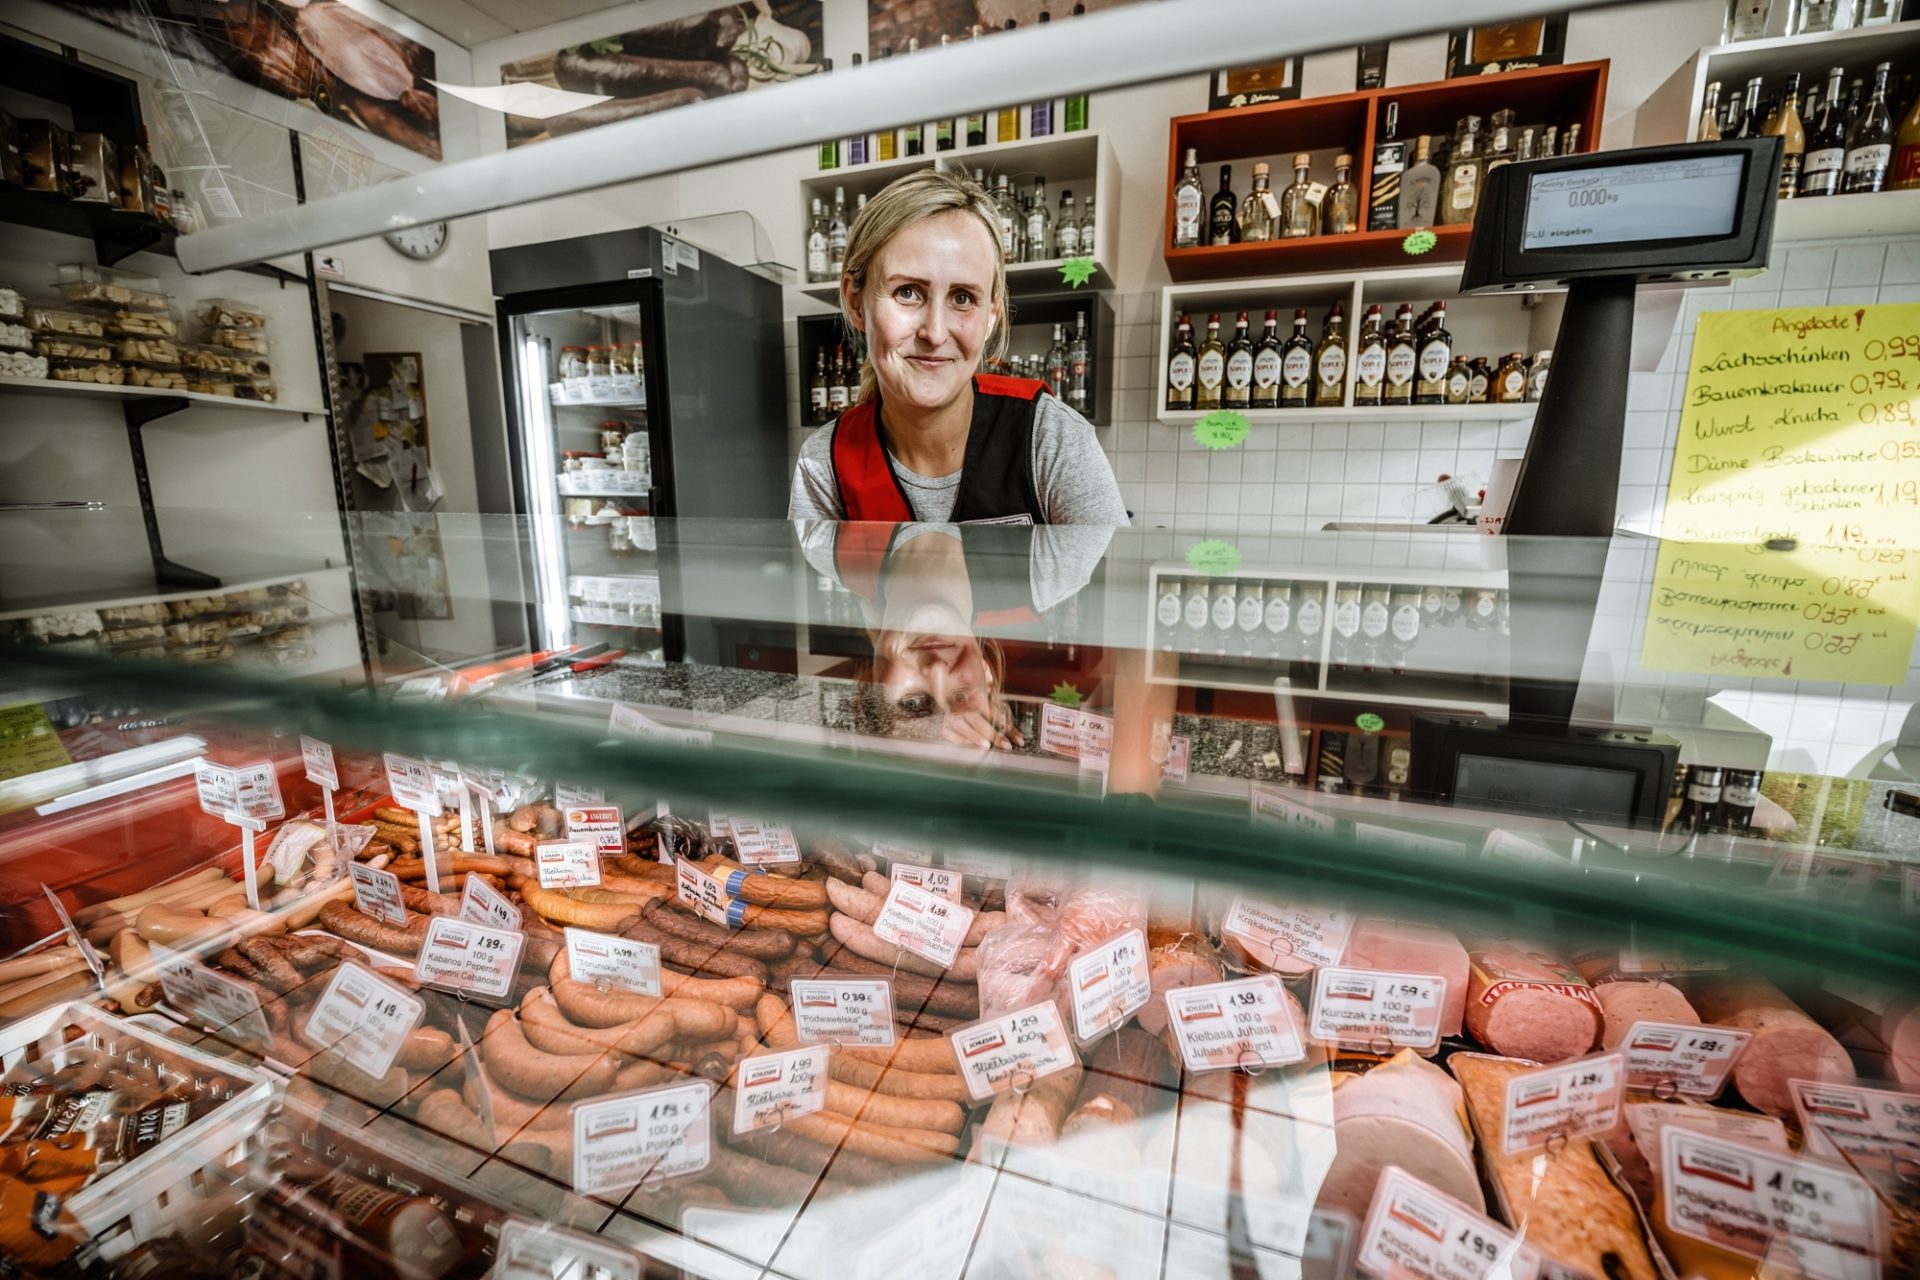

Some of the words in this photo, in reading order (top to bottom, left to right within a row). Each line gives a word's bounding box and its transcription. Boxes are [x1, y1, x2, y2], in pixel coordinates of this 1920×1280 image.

[1525, 231, 1545, 239] PLU
[1549, 227, 1593, 238] eingeben
[1695, 414, 1756, 441] Wurst
[1687, 454, 1750, 474] Dünne
[1780, 477, 1877, 507] gebackener
[1240, 903, 1290, 929] Krakowska
[1293, 924, 1323, 942] Sucha
[1329, 912, 1337, 921] €
[1237, 914, 1280, 935] Krakauer
[1282, 930, 1310, 948] Wurst
[1313, 922, 1321, 931] g
[440, 932, 464, 942] SCHLESIER
[472, 950, 487, 961] 100
[487, 955, 494, 963] g
[1296, 944, 1331, 964] Trocken
[428, 952, 462, 966] Kabanos
[466, 960, 500, 974] Peperoni
[424, 963, 459, 978] Peperoni
[461, 971, 502, 986] Cabanossi
[623, 976, 648, 988] Wurst
[844, 1006, 860, 1014] 100
[862, 1008, 868, 1016] g
[1185, 1003, 1214, 1013] SCHLESIER
[1320, 1007, 1366, 1020] Kurczak
[1370, 1012, 1377, 1021] z
[1383, 1001, 1401, 1011] 100
[1403, 1003, 1412, 1013] g
[1011, 1014, 1039, 1033] 1,29
[1233, 1012, 1252, 1023] 100
[1254, 1013, 1262, 1023] g
[1236, 1024, 1278, 1037] Juhasa
[1319, 1020, 1370, 1033] Gegartes
[1374, 1026, 1432, 1038] Hähnchen
[861, 1035, 882, 1043] Wurst
[969, 1034, 997, 1049] SCHLESIER
[1191, 1045, 1234, 1058] Juhas's
[1237, 1039, 1273, 1052] Wurst
[790, 1057, 812, 1072] 1,99
[751, 1068, 777, 1079] SCHLESIER
[648, 1124, 668, 1137] 100
[671, 1123, 679, 1135] g
